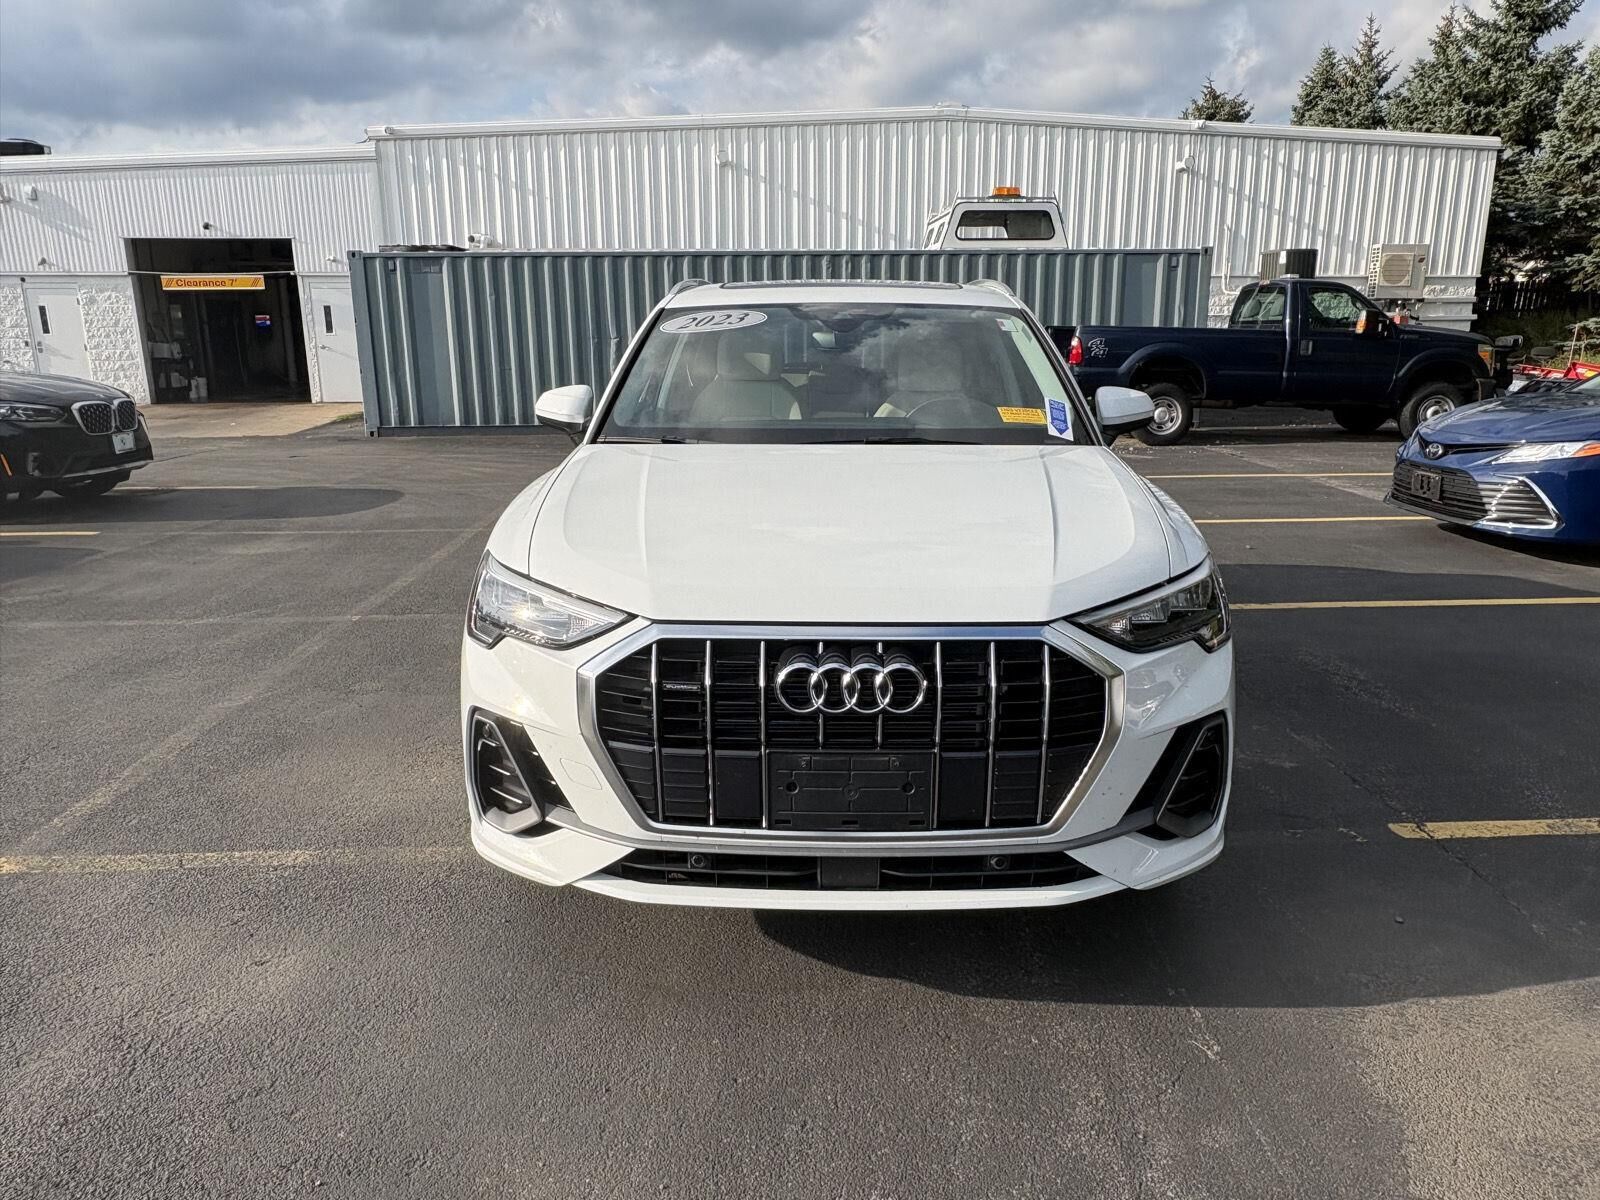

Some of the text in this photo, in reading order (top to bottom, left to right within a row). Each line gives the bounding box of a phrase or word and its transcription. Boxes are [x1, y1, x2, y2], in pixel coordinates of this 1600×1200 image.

[175, 278, 238, 287] Clearance 7'
[677, 312, 750, 330] 2023
